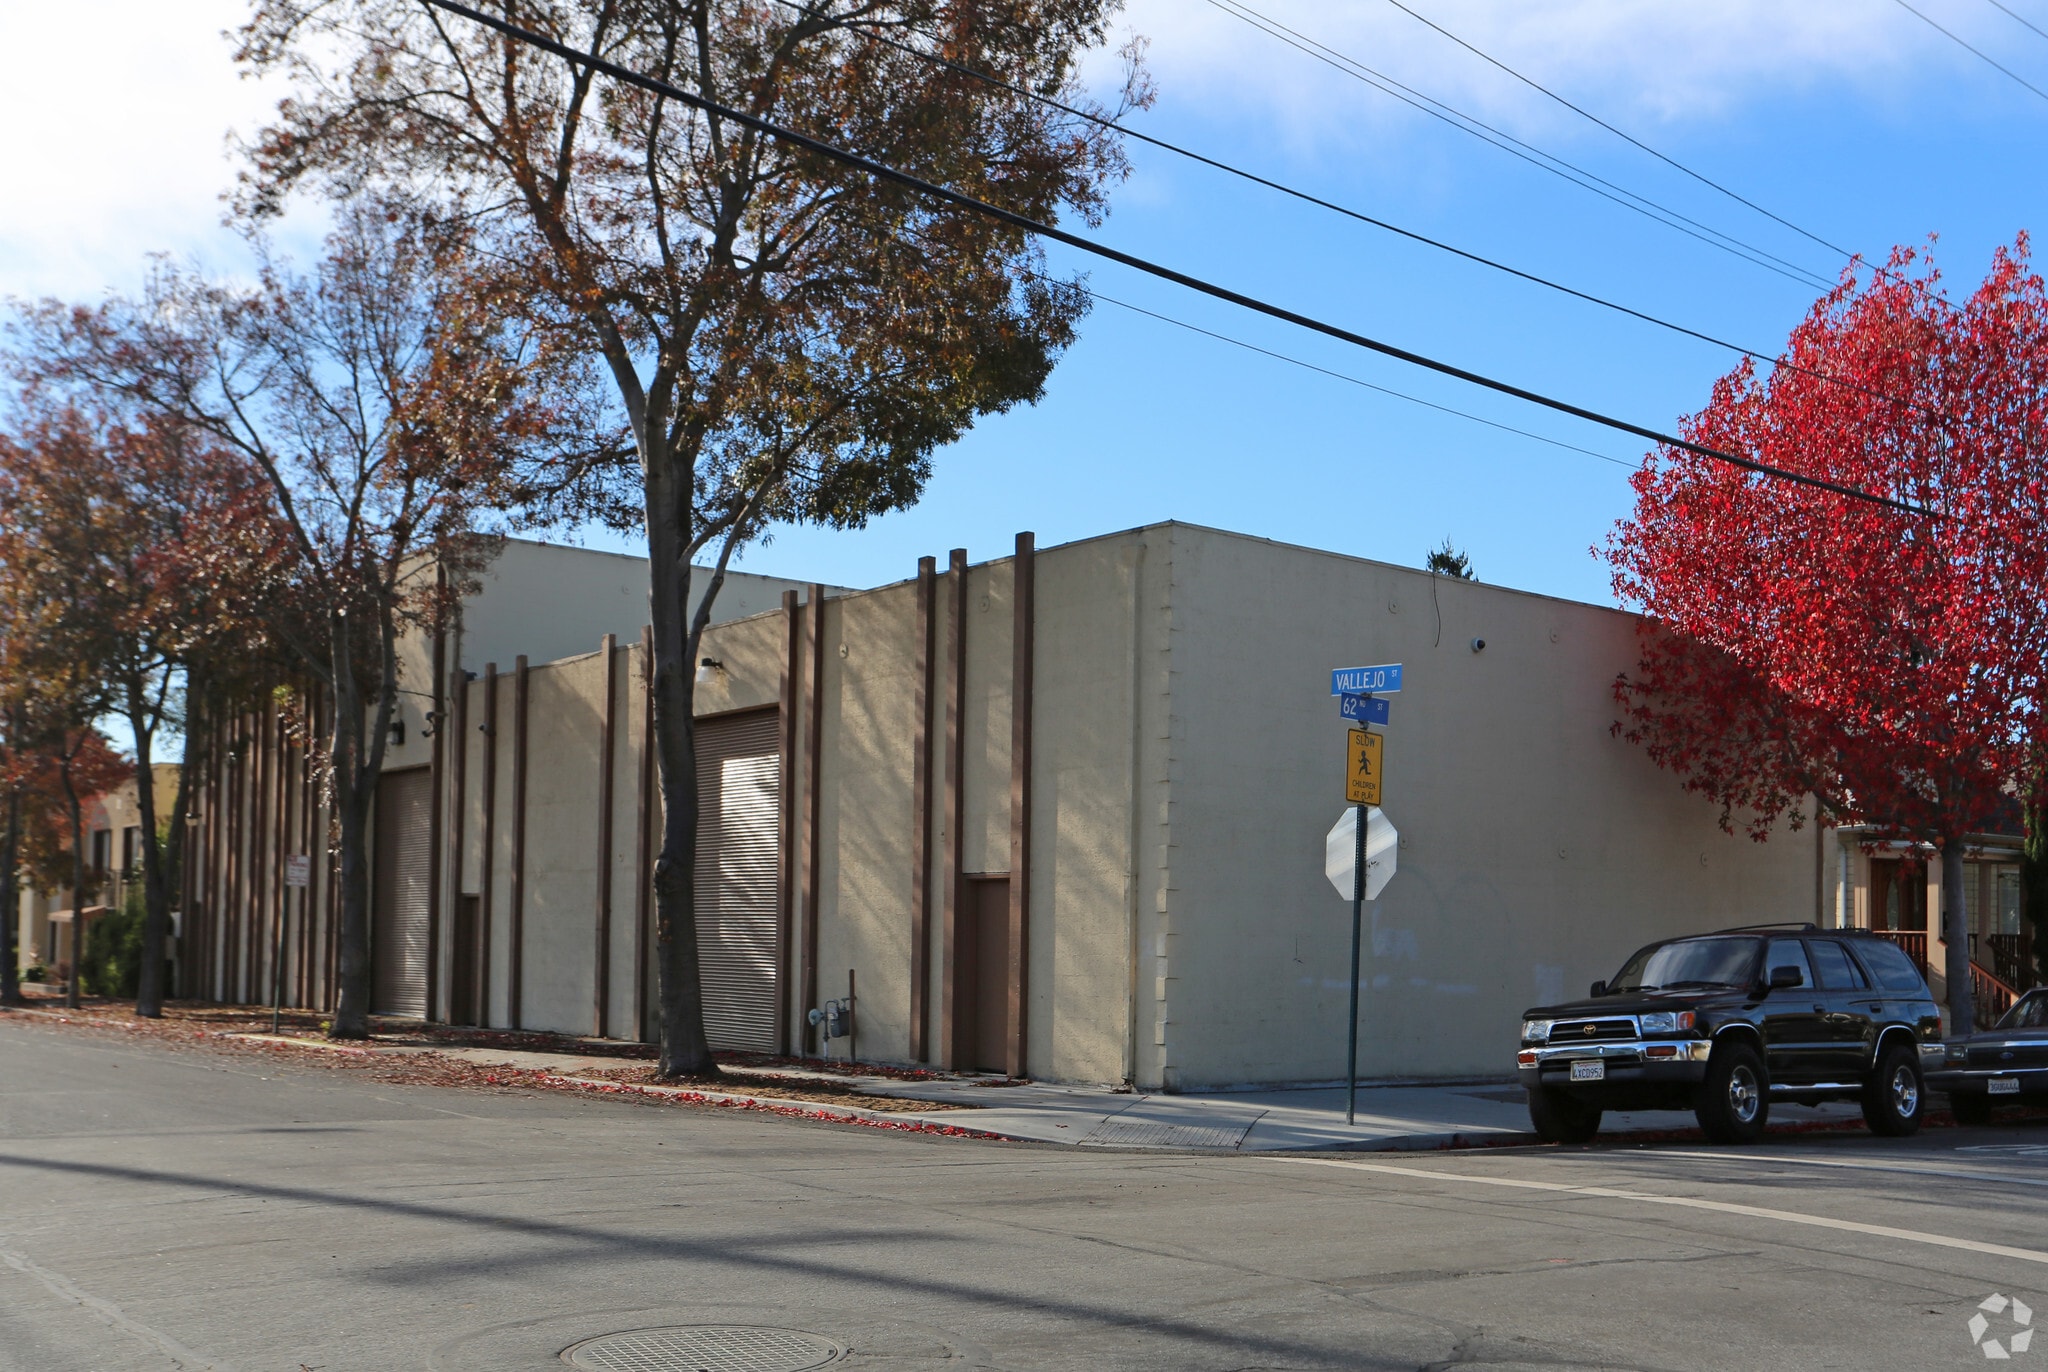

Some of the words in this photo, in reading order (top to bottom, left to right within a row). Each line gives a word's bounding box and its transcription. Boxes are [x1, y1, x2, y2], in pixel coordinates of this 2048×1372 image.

[1336, 670, 1385, 690] VALLEJO
[1391, 669, 1398, 678] ST
[1377, 703, 1383, 711] ST
[1355, 734, 1375, 748] SLOW
[1352, 779, 1376, 790] CHILDREN
[1353, 790, 1360, 798] AT
[1361, 791, 1374, 800] PLAY
